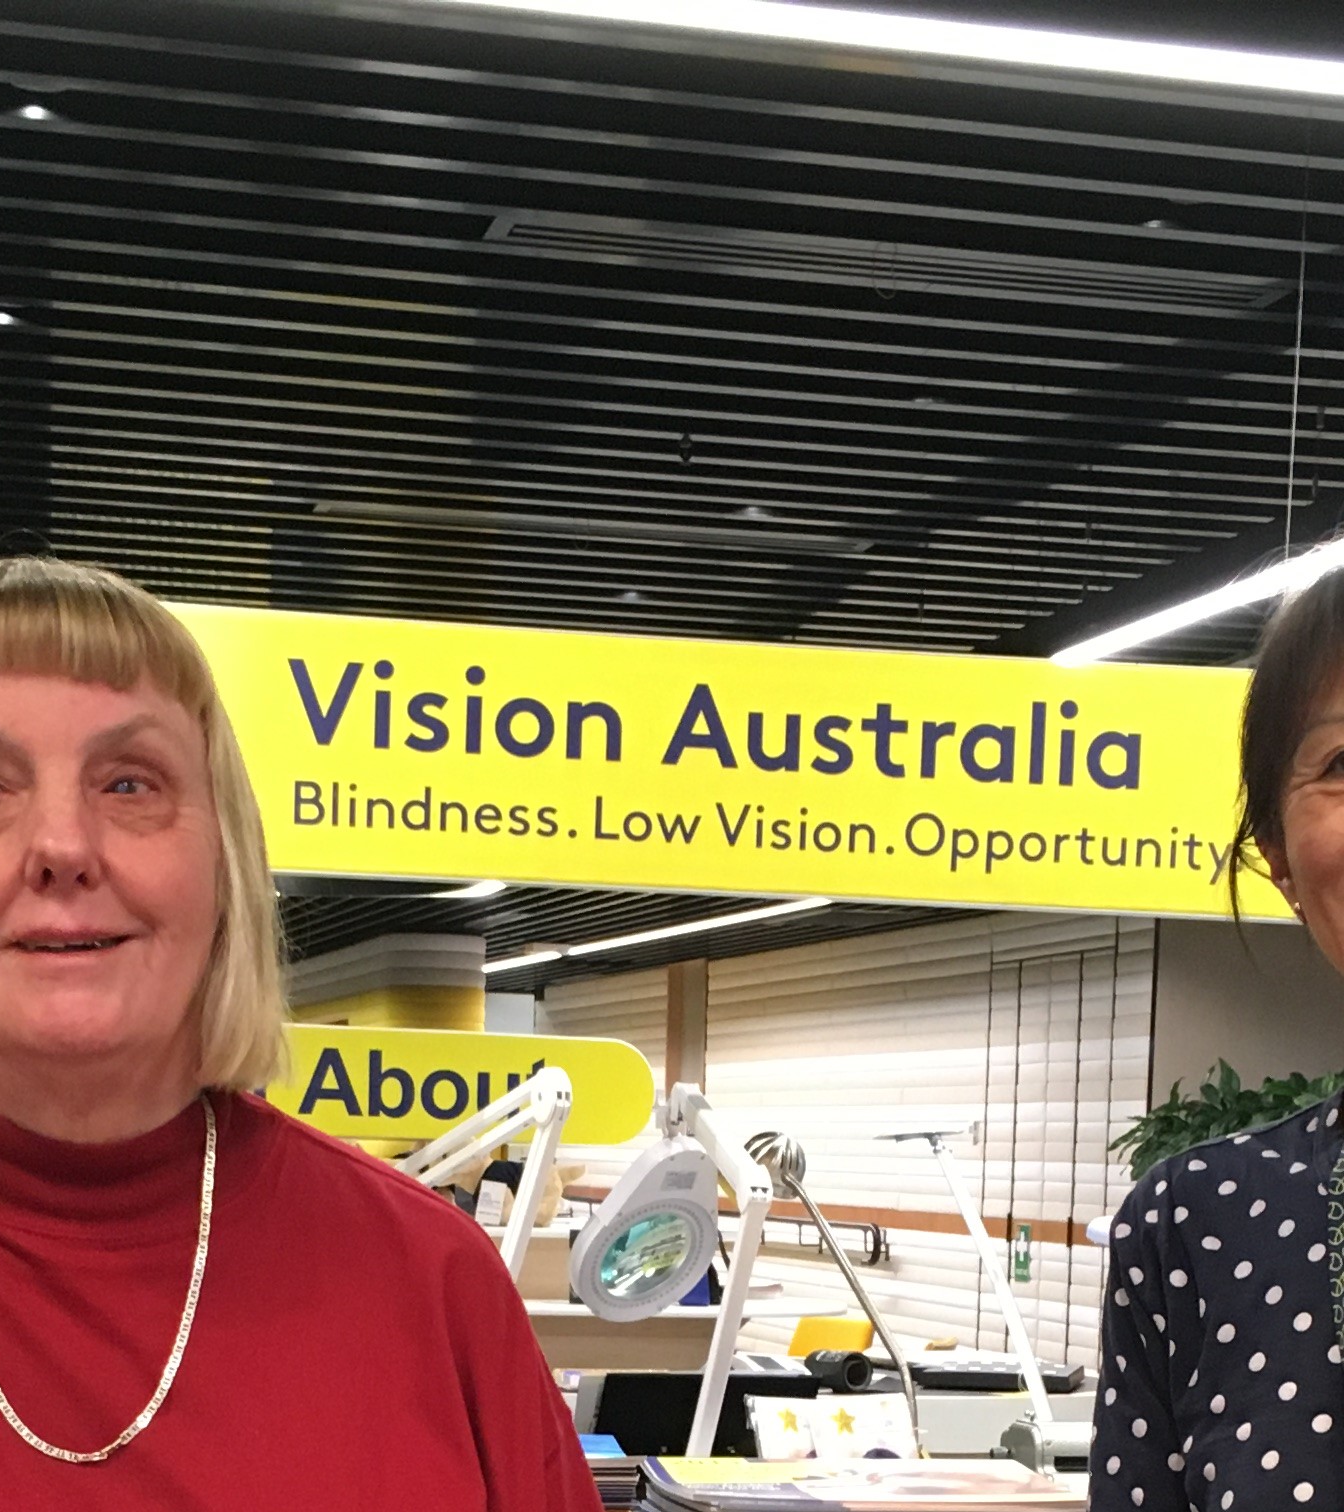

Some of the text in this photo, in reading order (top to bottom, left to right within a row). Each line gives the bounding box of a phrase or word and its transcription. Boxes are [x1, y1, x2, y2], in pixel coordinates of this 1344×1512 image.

[288, 658, 1142, 790] Vision Australia
[294, 781, 578, 838] Blindness.
[595, 796, 701, 845] Low
